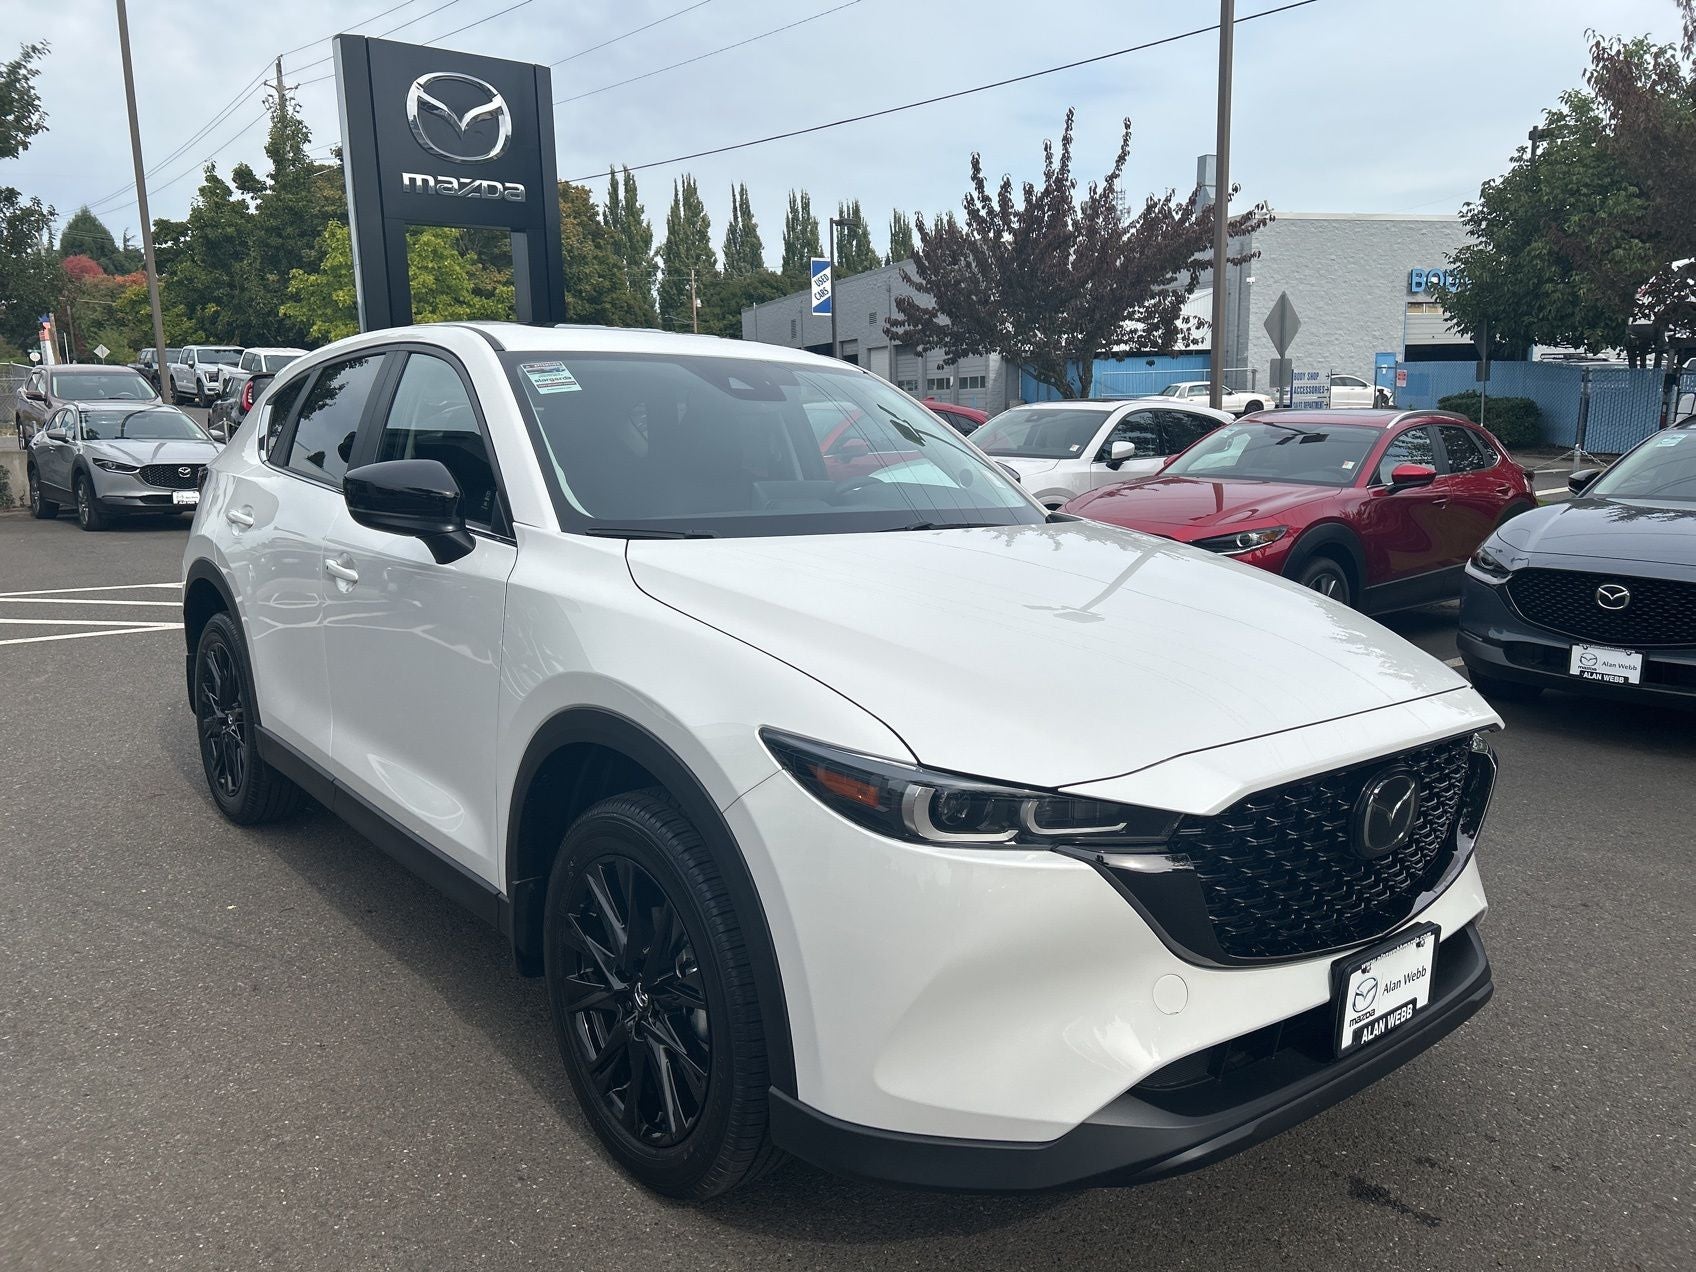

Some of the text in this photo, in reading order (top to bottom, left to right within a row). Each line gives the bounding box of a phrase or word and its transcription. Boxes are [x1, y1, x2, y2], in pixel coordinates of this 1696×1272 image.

[814, 273, 830, 287] USED
[814, 287, 829, 300] CARS
[1294, 386, 1325, 394] ACCESSORIES
[1618, 663, 1638, 671] Webb
[1583, 671, 1625, 683] ALAN WEBB
[1382, 965, 1427, 996] Alan Webb
[1361, 1003, 1413, 1045] ALAN WEBB
